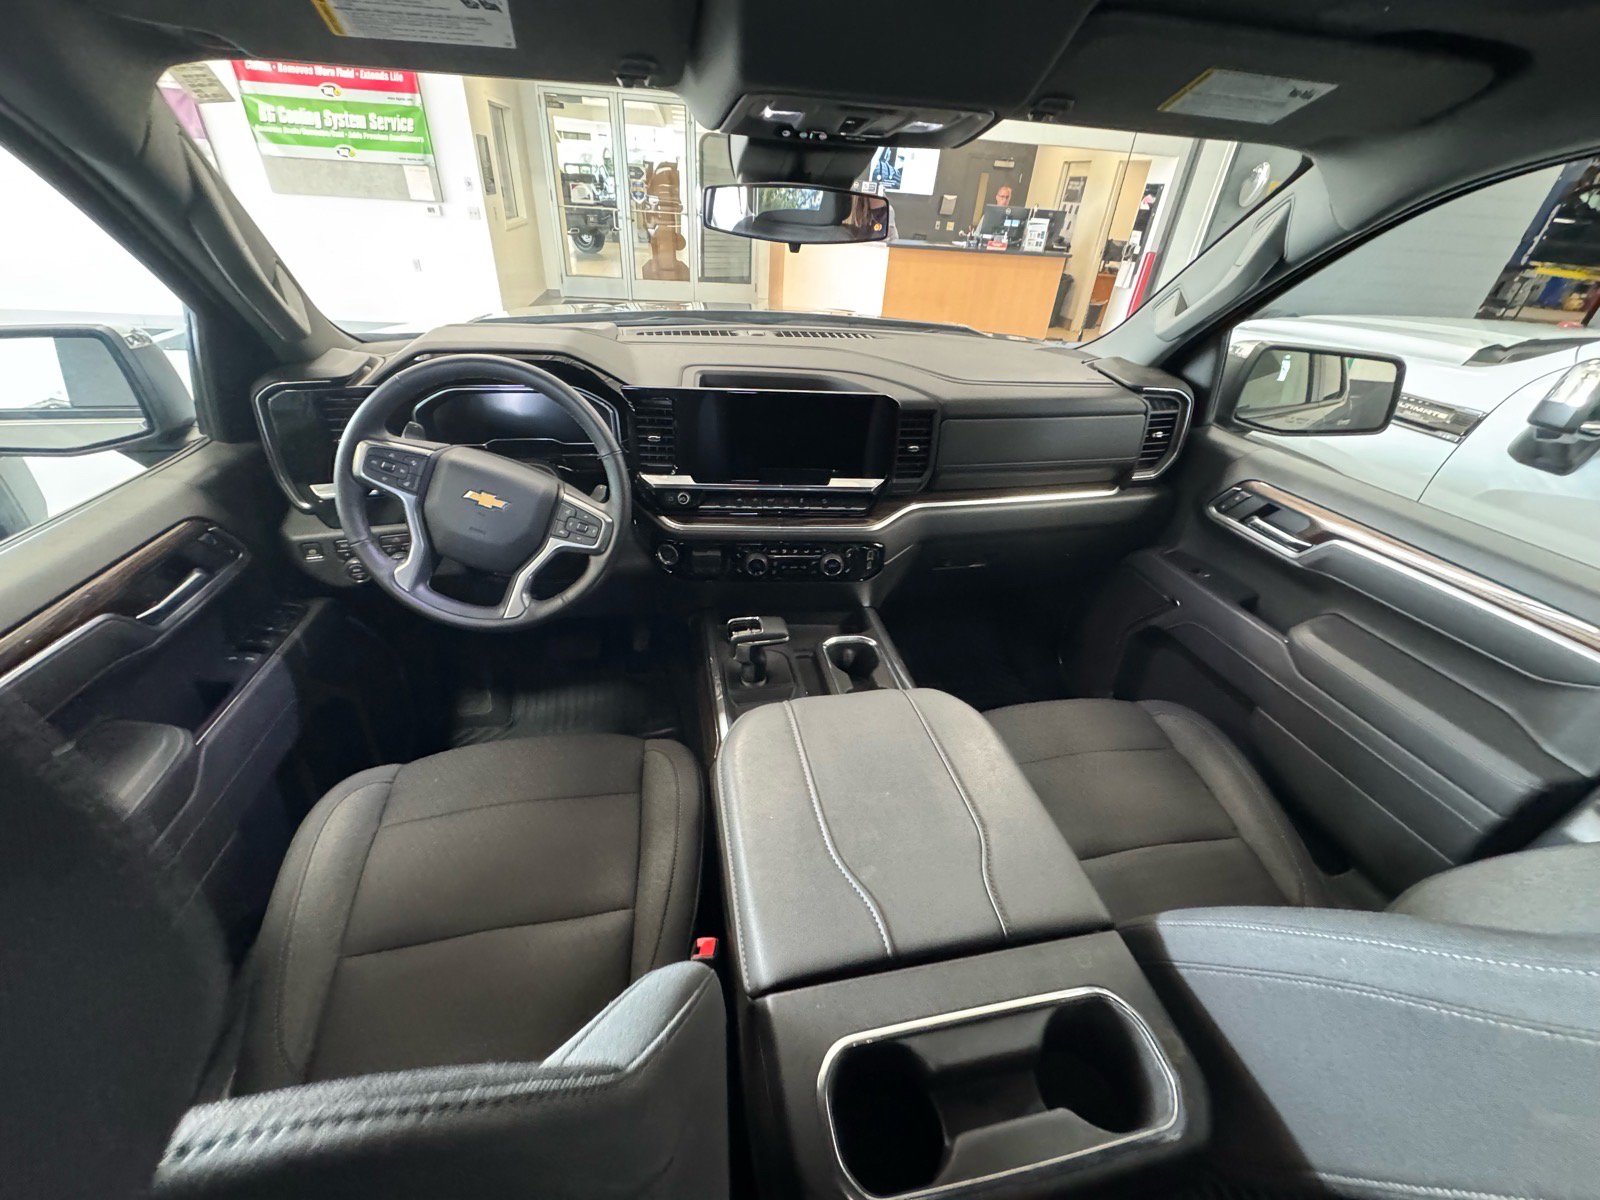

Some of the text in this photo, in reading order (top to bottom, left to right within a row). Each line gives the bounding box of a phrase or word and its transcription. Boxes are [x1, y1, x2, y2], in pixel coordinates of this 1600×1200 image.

[277, 62, 314, 75] Removes
[360, 69, 389, 81] Extends
[390, 71, 403, 83] Life
[323, 109, 367, 130] System
[369, 112, 414, 132] Service
